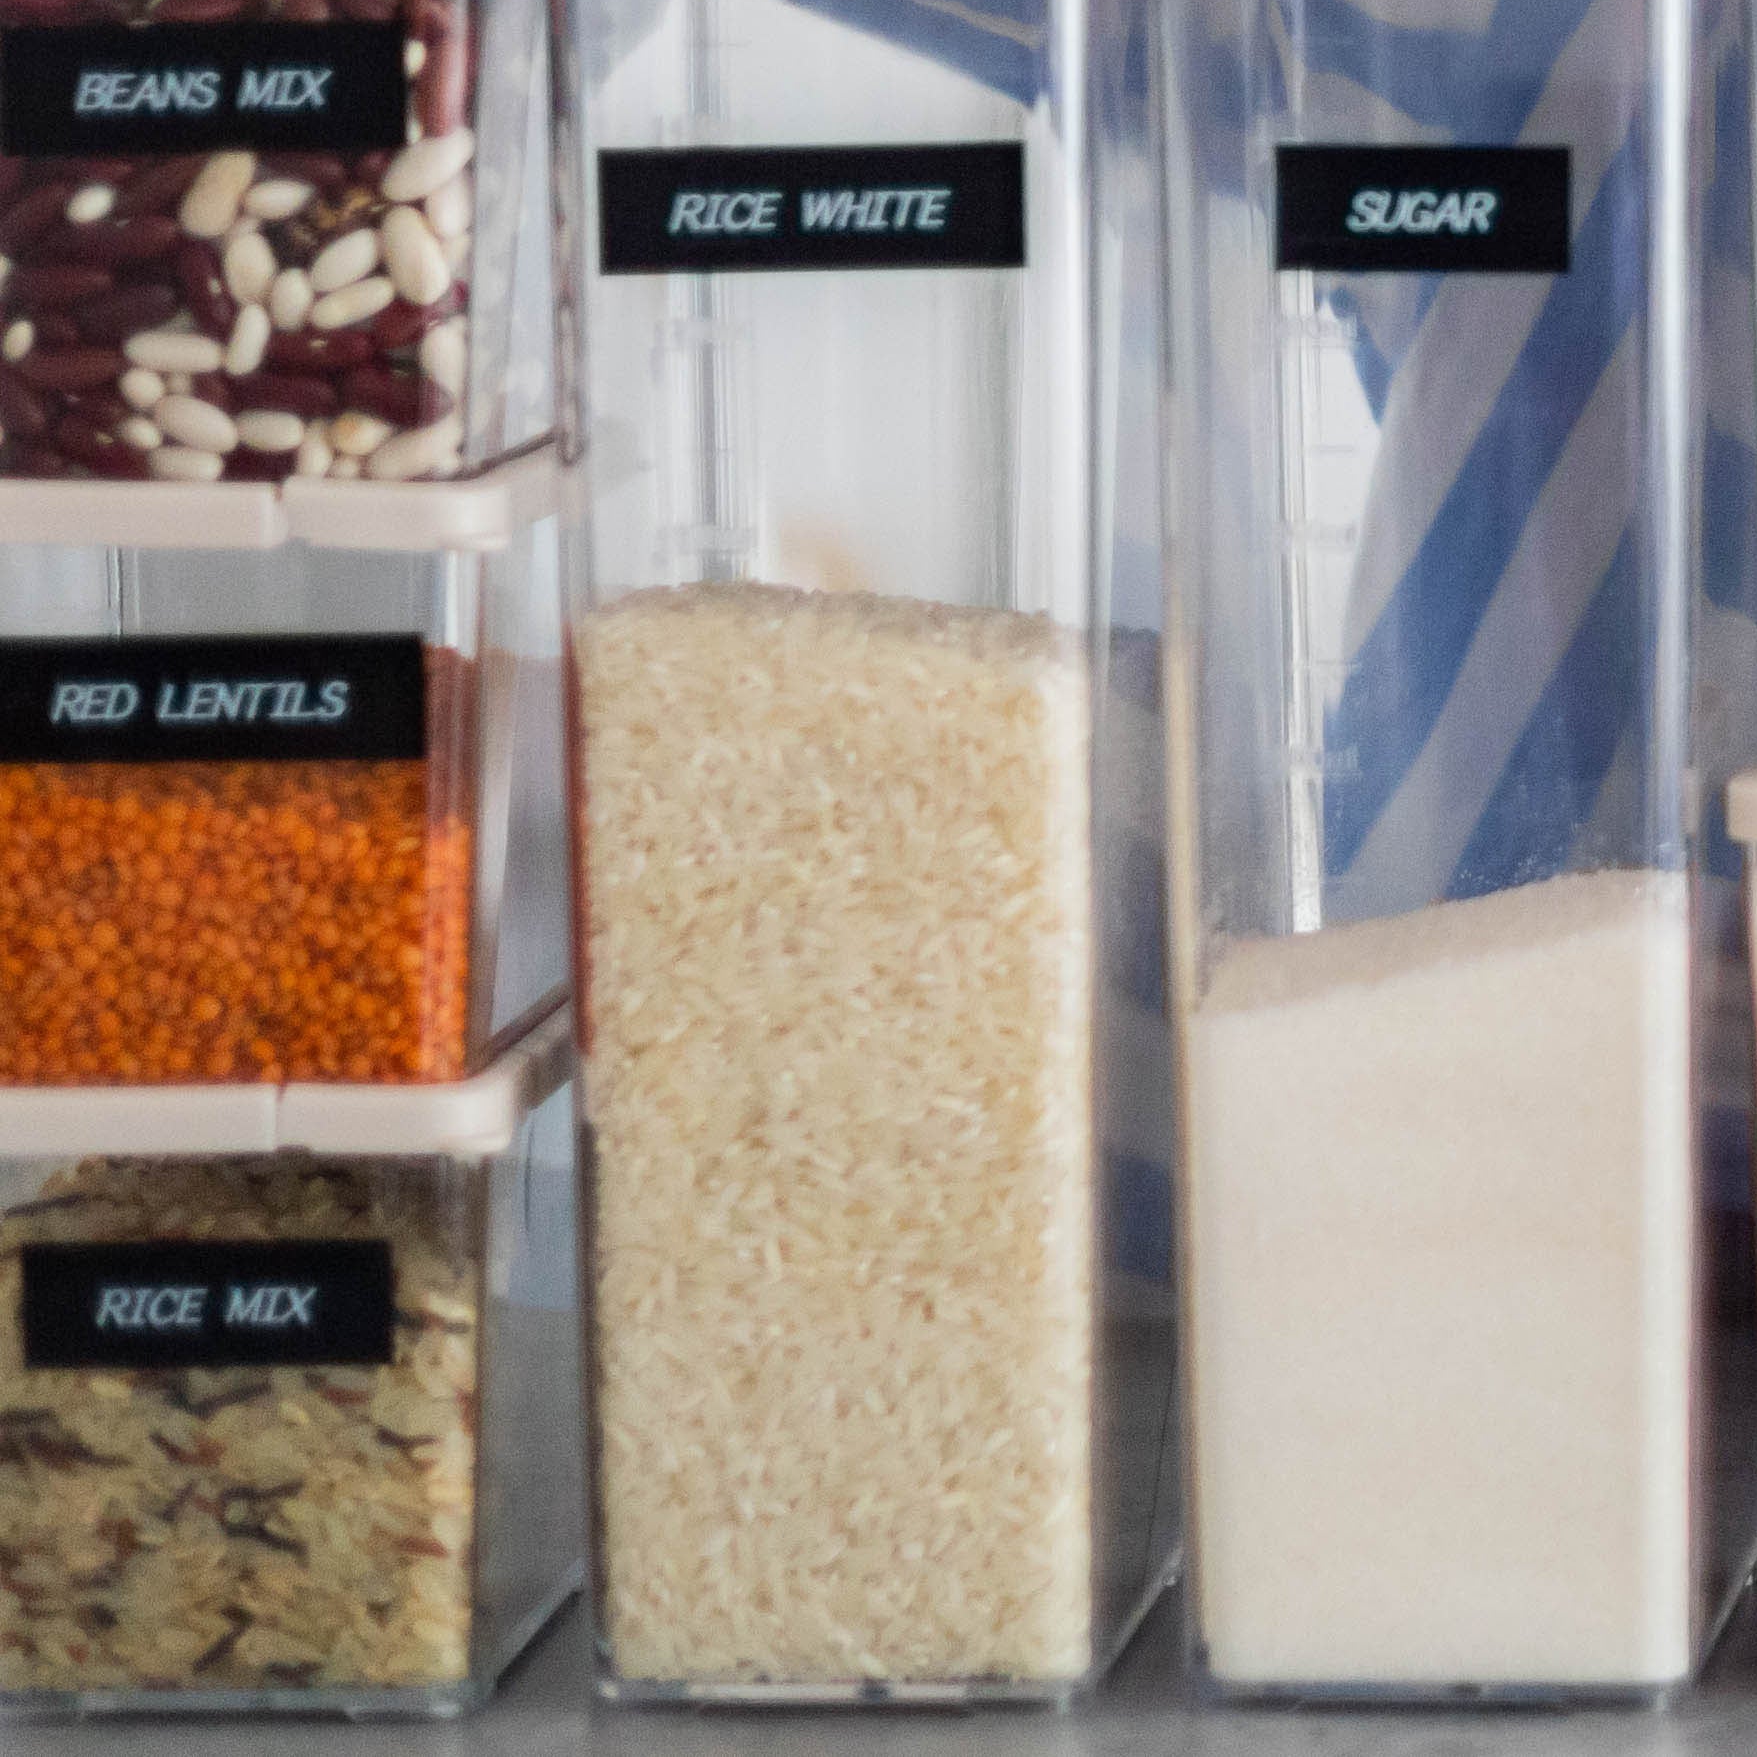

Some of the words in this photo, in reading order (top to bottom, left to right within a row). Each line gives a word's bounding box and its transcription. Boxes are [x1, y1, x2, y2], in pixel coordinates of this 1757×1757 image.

[75, 70, 218, 112] BEANS
[237, 69, 332, 108] MIX
[667, 191, 782, 233] RICE
[802, 187, 952, 230] WHITE
[1346, 188, 1497, 233] SUGAR
[51, 682, 139, 723] RED
[156, 680, 350, 721] LENTILS
[96, 1286, 208, 1328] RICE
[224, 1285, 318, 1326] MIX
